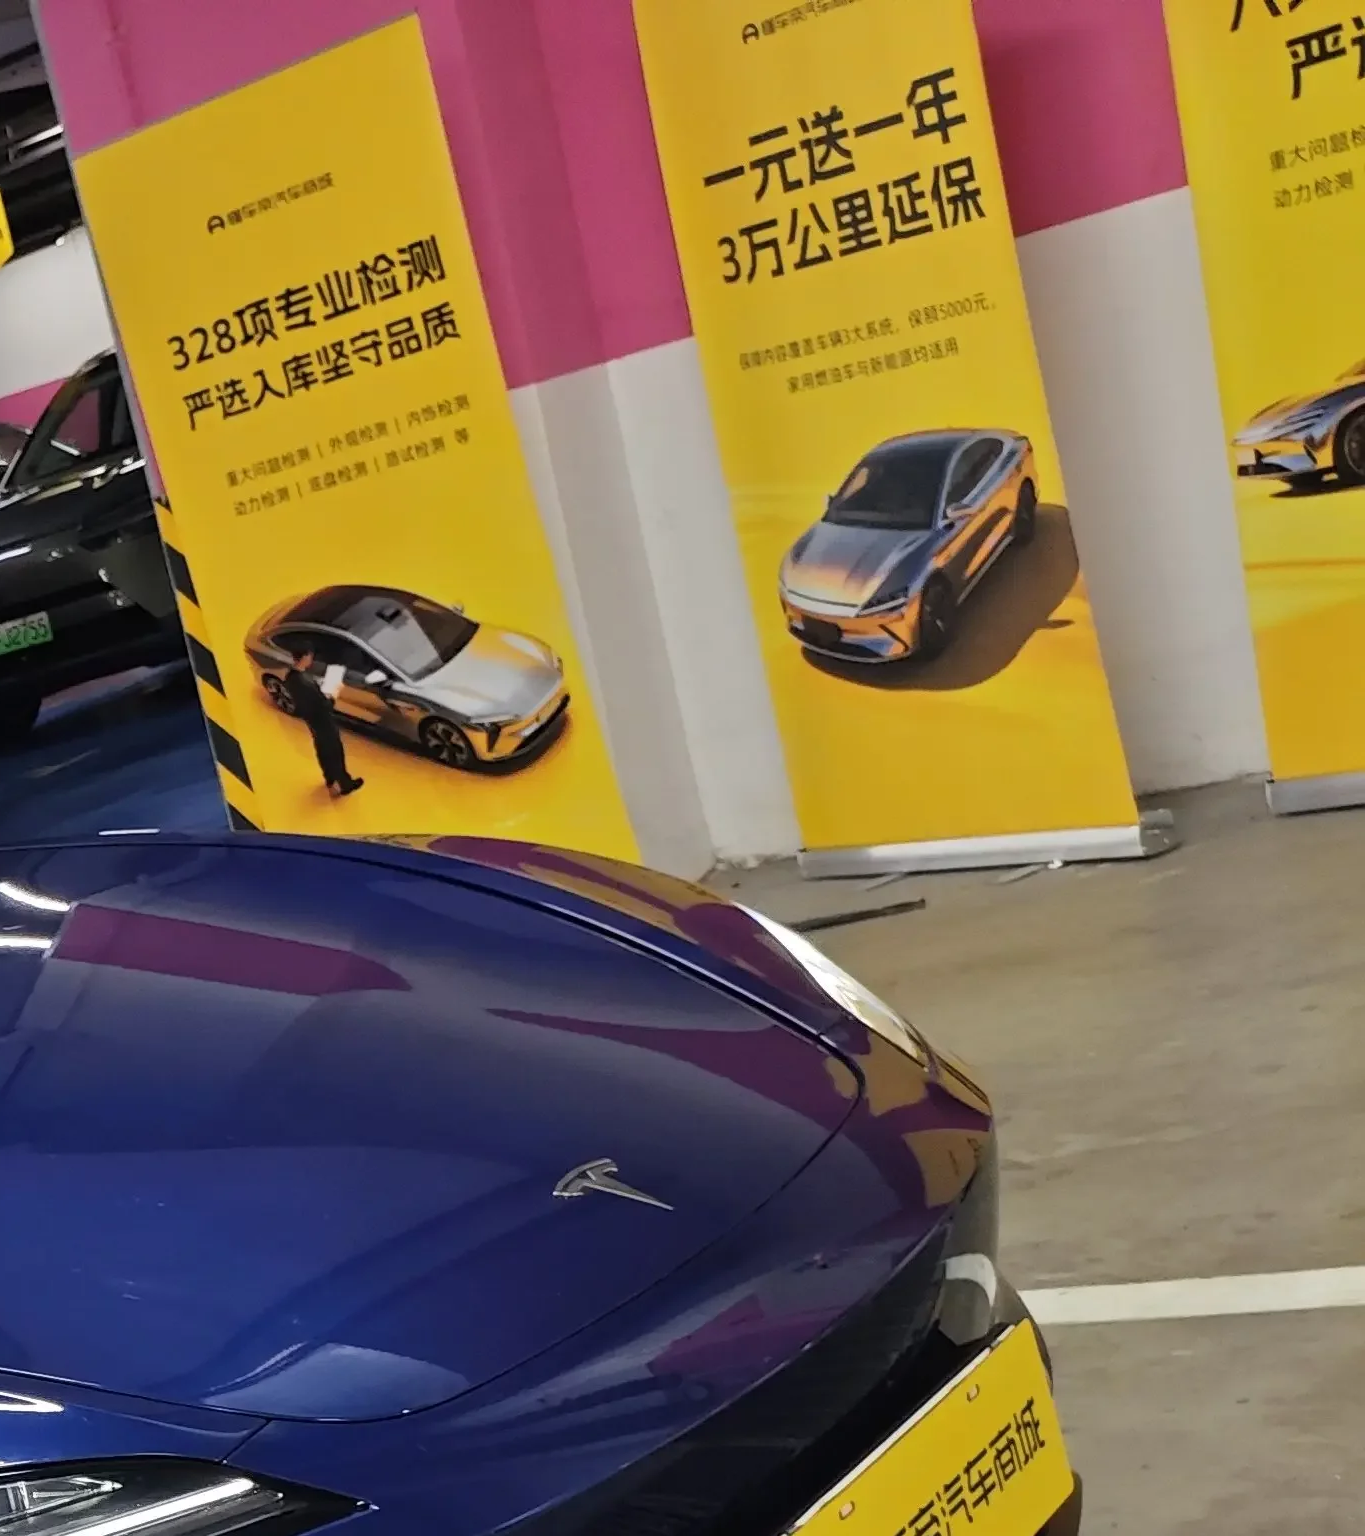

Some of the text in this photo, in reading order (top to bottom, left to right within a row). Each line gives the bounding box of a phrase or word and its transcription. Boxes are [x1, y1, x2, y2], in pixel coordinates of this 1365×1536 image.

[1285, 16, 1365, 101] 严
[702, 67, 967, 203] 一元送一年
[717, 156, 987, 284] 3万公里延保
[167, 234, 447, 371] 328项专业检测
[182, 302, 462, 431] 严选入库坚守品质
